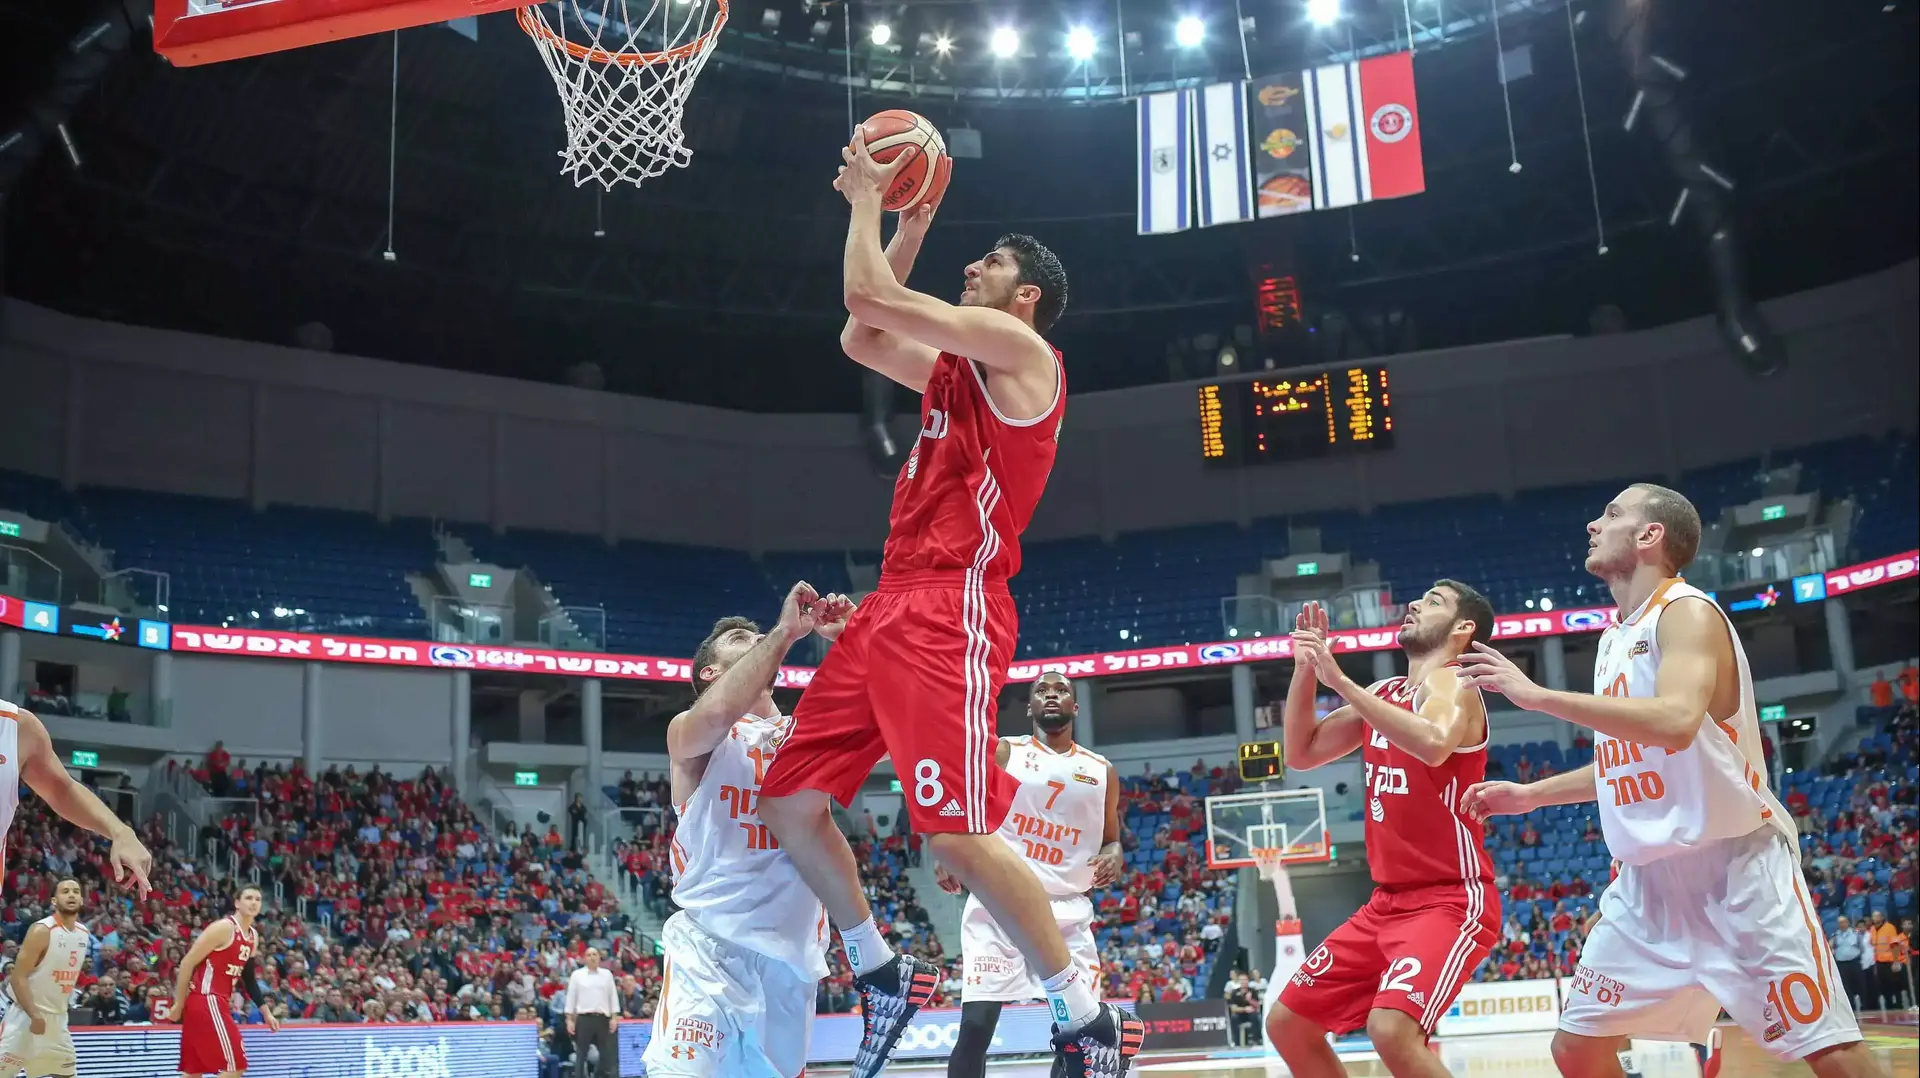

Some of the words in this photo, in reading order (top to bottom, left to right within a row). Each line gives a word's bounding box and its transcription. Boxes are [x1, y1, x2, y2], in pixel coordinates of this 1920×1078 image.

[1827, 558, 1920, 590] פשר
[1801, 582, 1815, 598] 7
[34, 610, 49, 628] 4
[145, 626, 158, 644] 5
[915, 758, 944, 807] 8
[1607, 770, 1665, 807] סחר
[1045, 780, 1066, 810] 7
[939, 808, 965, 817] adidas
[1013, 812, 1082, 846] דיזנגוף
[1022, 838, 1064, 866] סחר
[69, 950, 78, 967] 5
[1379, 956, 1422, 992] 12
[1596, 986, 1622, 1008] נס
[1766, 972, 1823, 1032] 10
[153, 999, 171, 1020] 5
[676, 1017, 714, 1033] התרבות
[674, 1027, 714, 1048] ציונה
